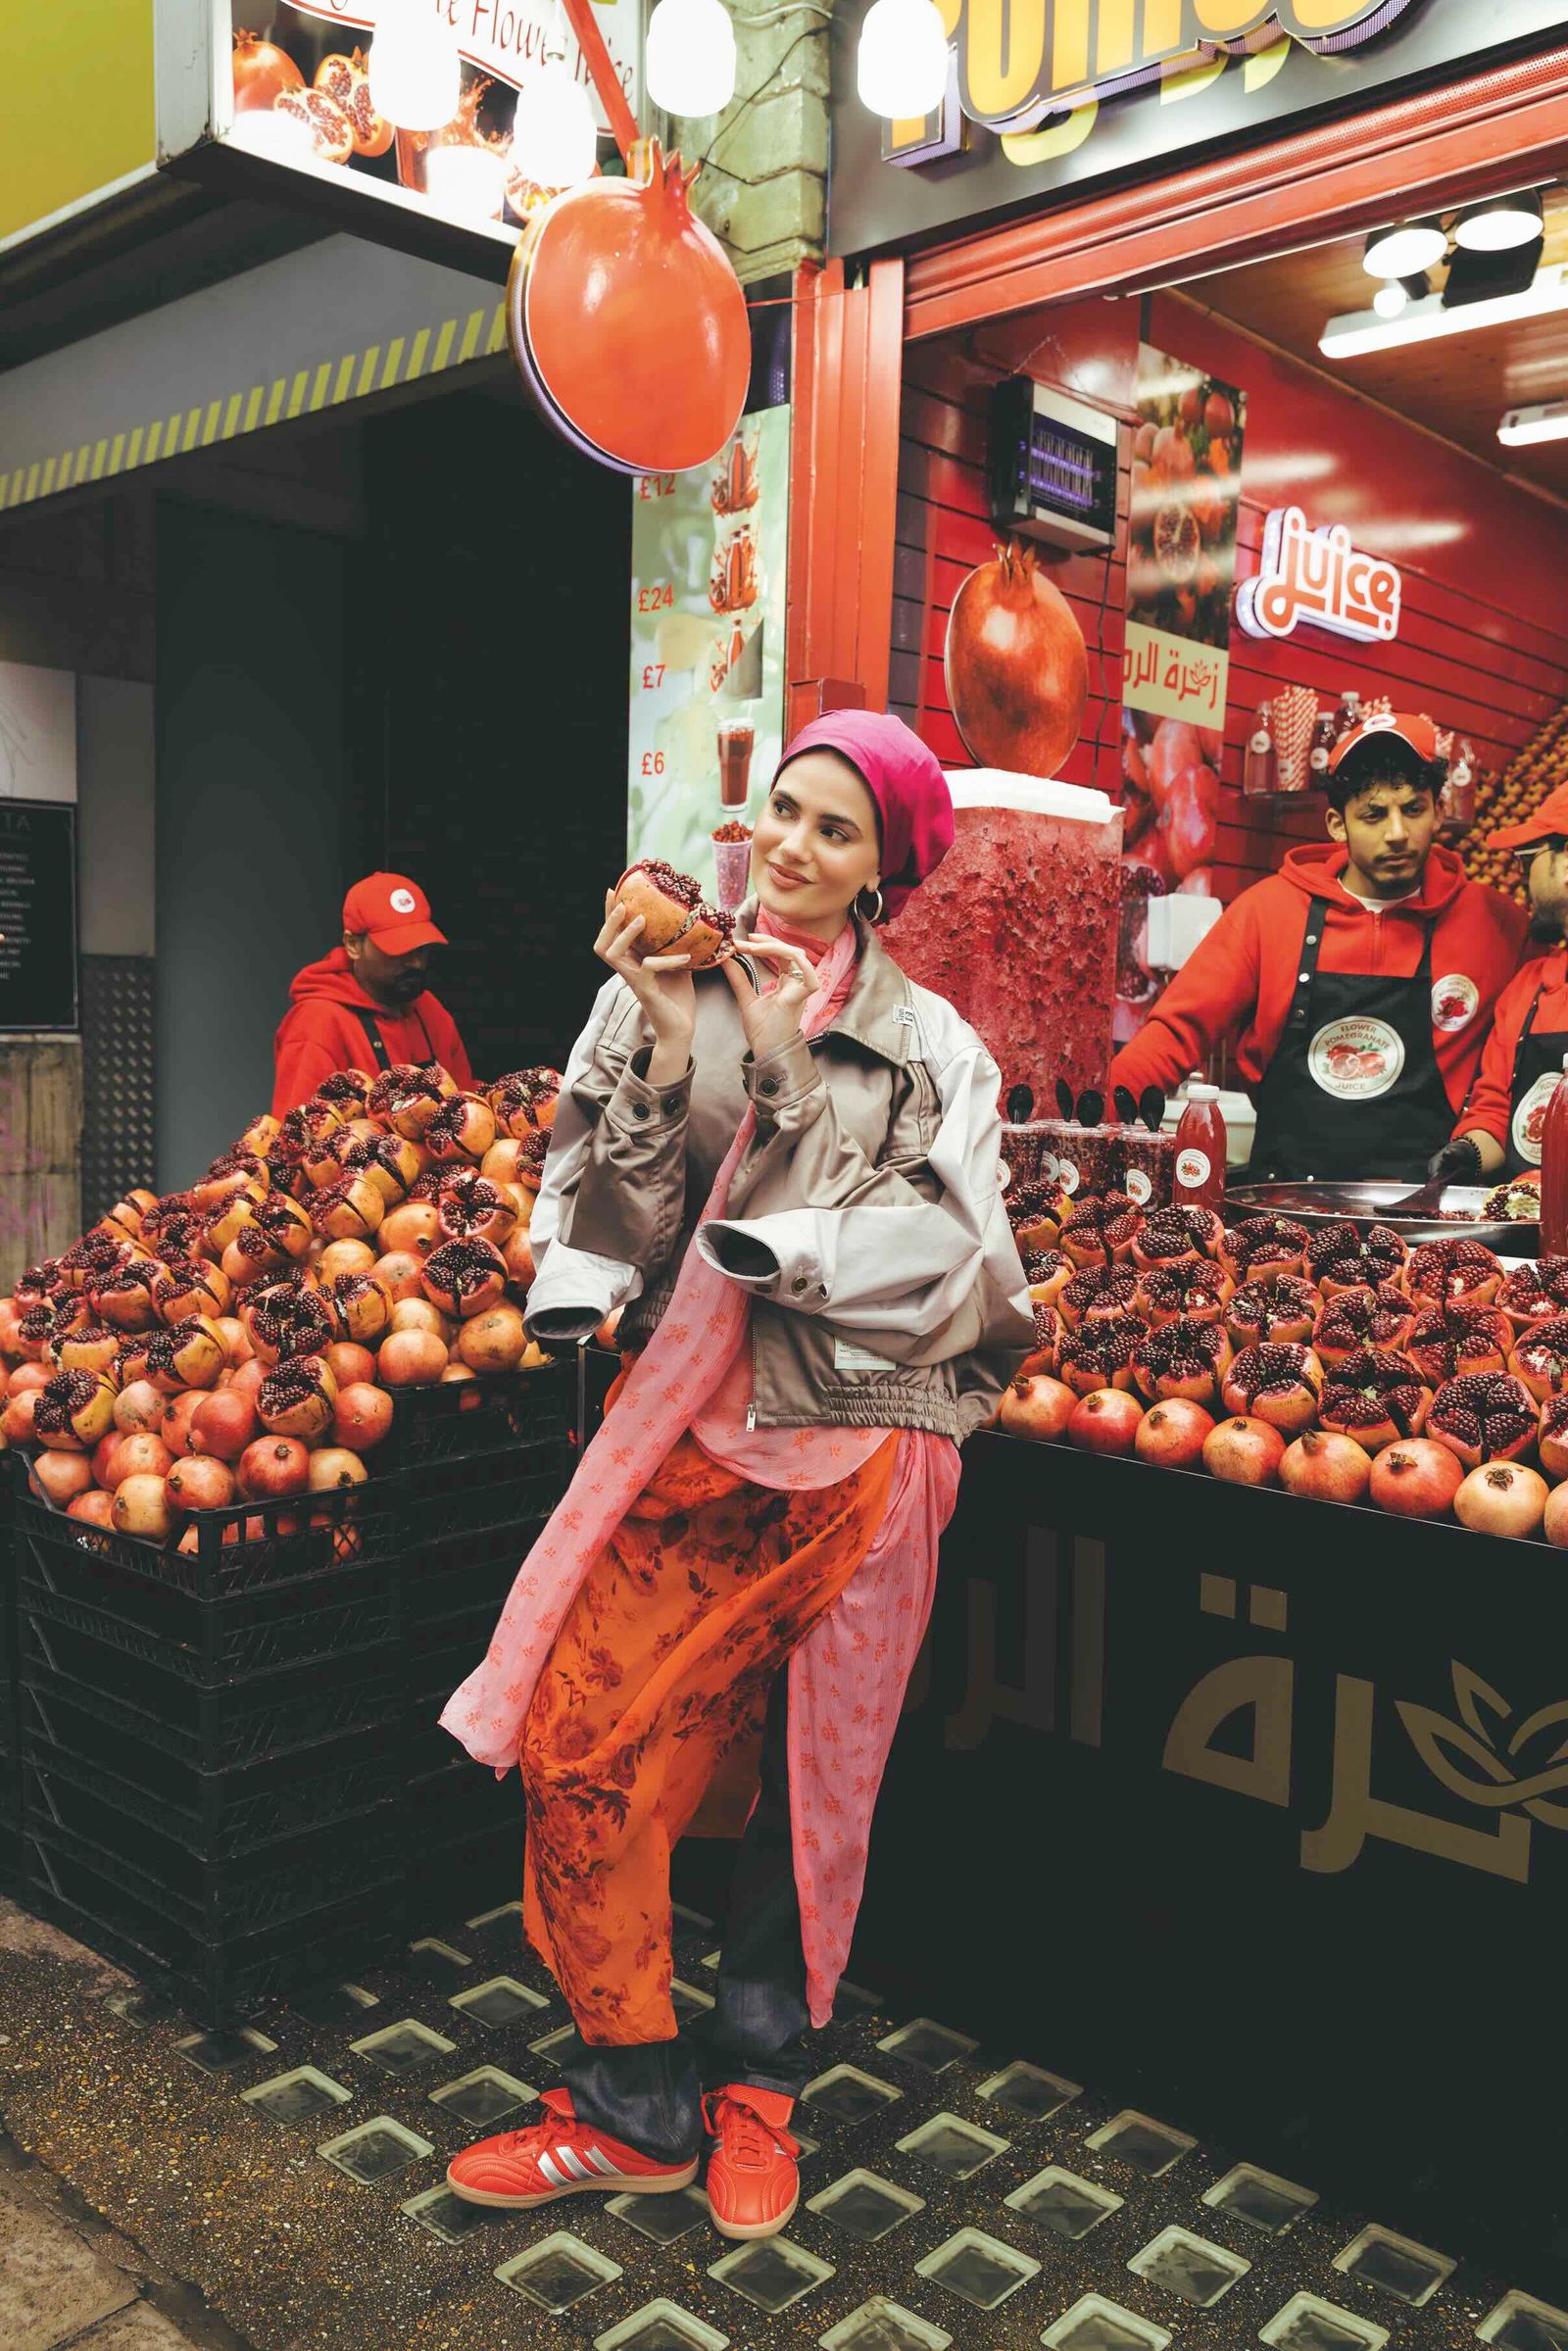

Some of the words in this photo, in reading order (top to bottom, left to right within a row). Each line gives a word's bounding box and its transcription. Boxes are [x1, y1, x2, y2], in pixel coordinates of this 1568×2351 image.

[640, 473, 675, 502] £12
[638, 584, 674, 612] £24
[643, 664, 666, 690] £7
[642, 752, 665, 776] £6
[1324, 1031, 1391, 1050] POMEGRANATE
[1341, 1023, 1377, 1034] FLOWER
[1335, 1082, 1365, 1091] JUICE
